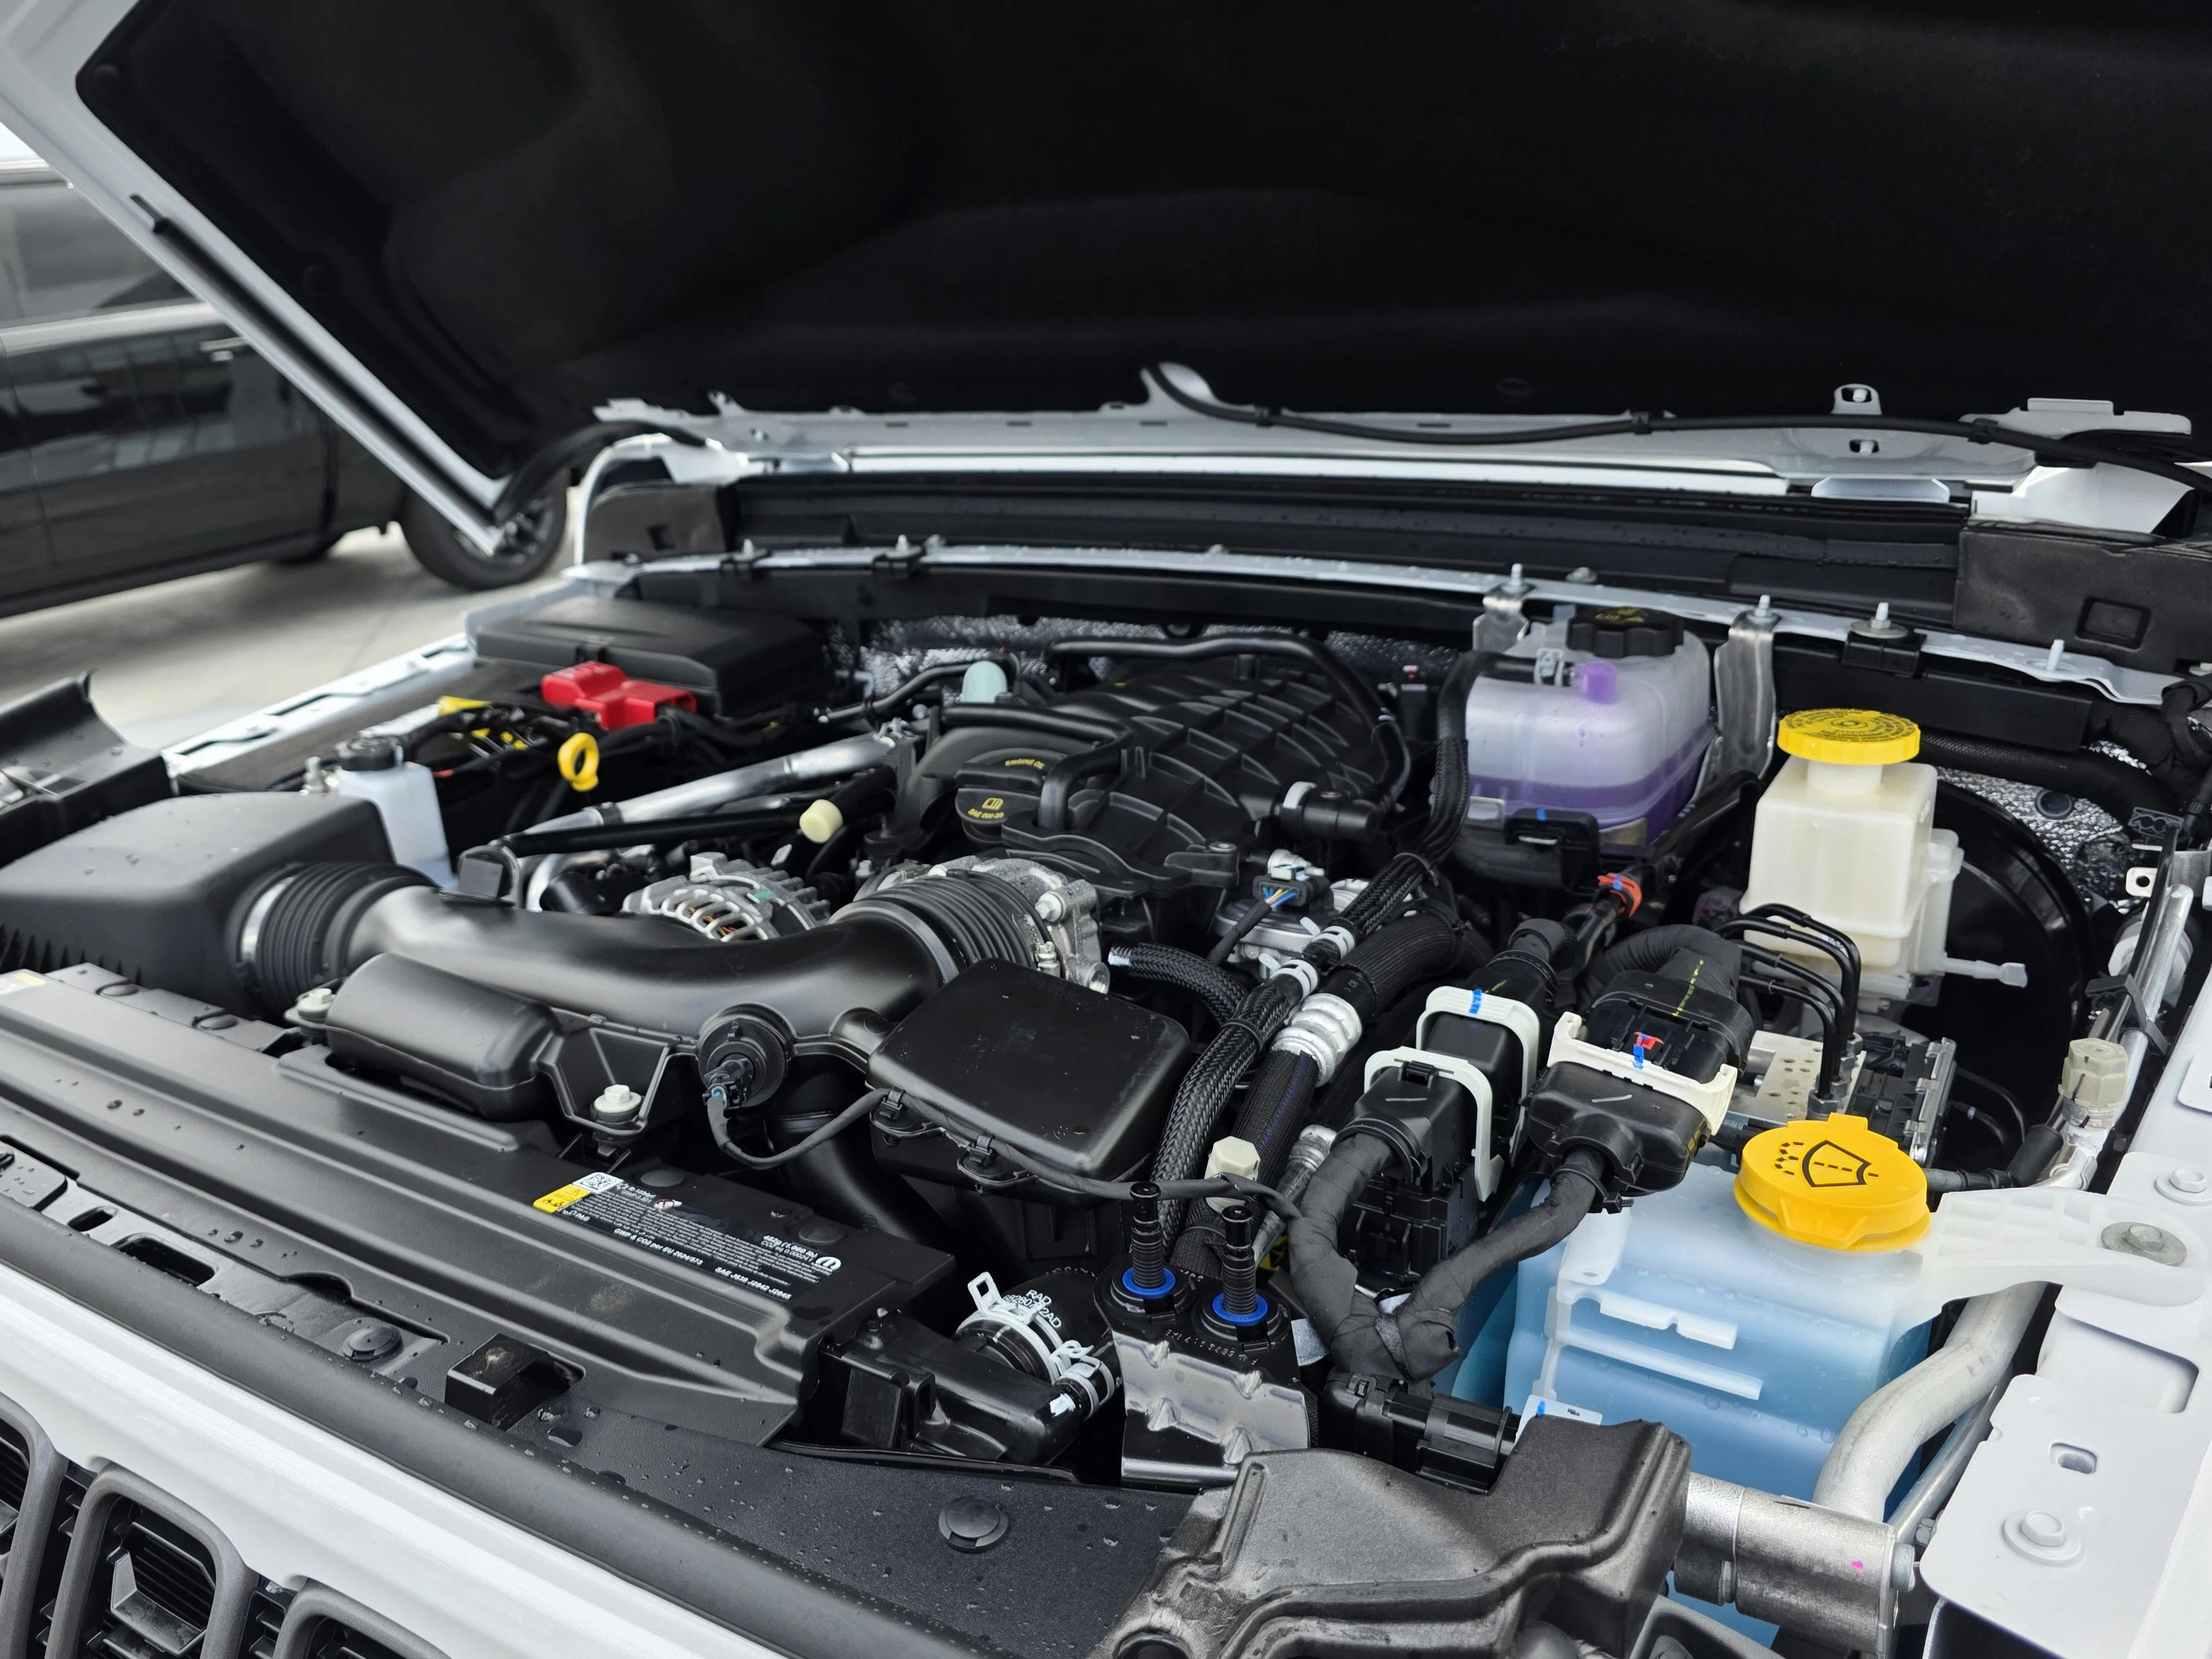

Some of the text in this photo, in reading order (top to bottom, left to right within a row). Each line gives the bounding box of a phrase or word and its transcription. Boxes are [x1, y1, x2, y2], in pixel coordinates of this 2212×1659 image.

[968, 809, 983, 818] SAE
[613, 1229, 632, 1237] GWP
[805, 1250, 818, 1258] lb)
[715, 1267, 732, 1277] SAE
[1026, 1289, 1052, 1305] RAD
